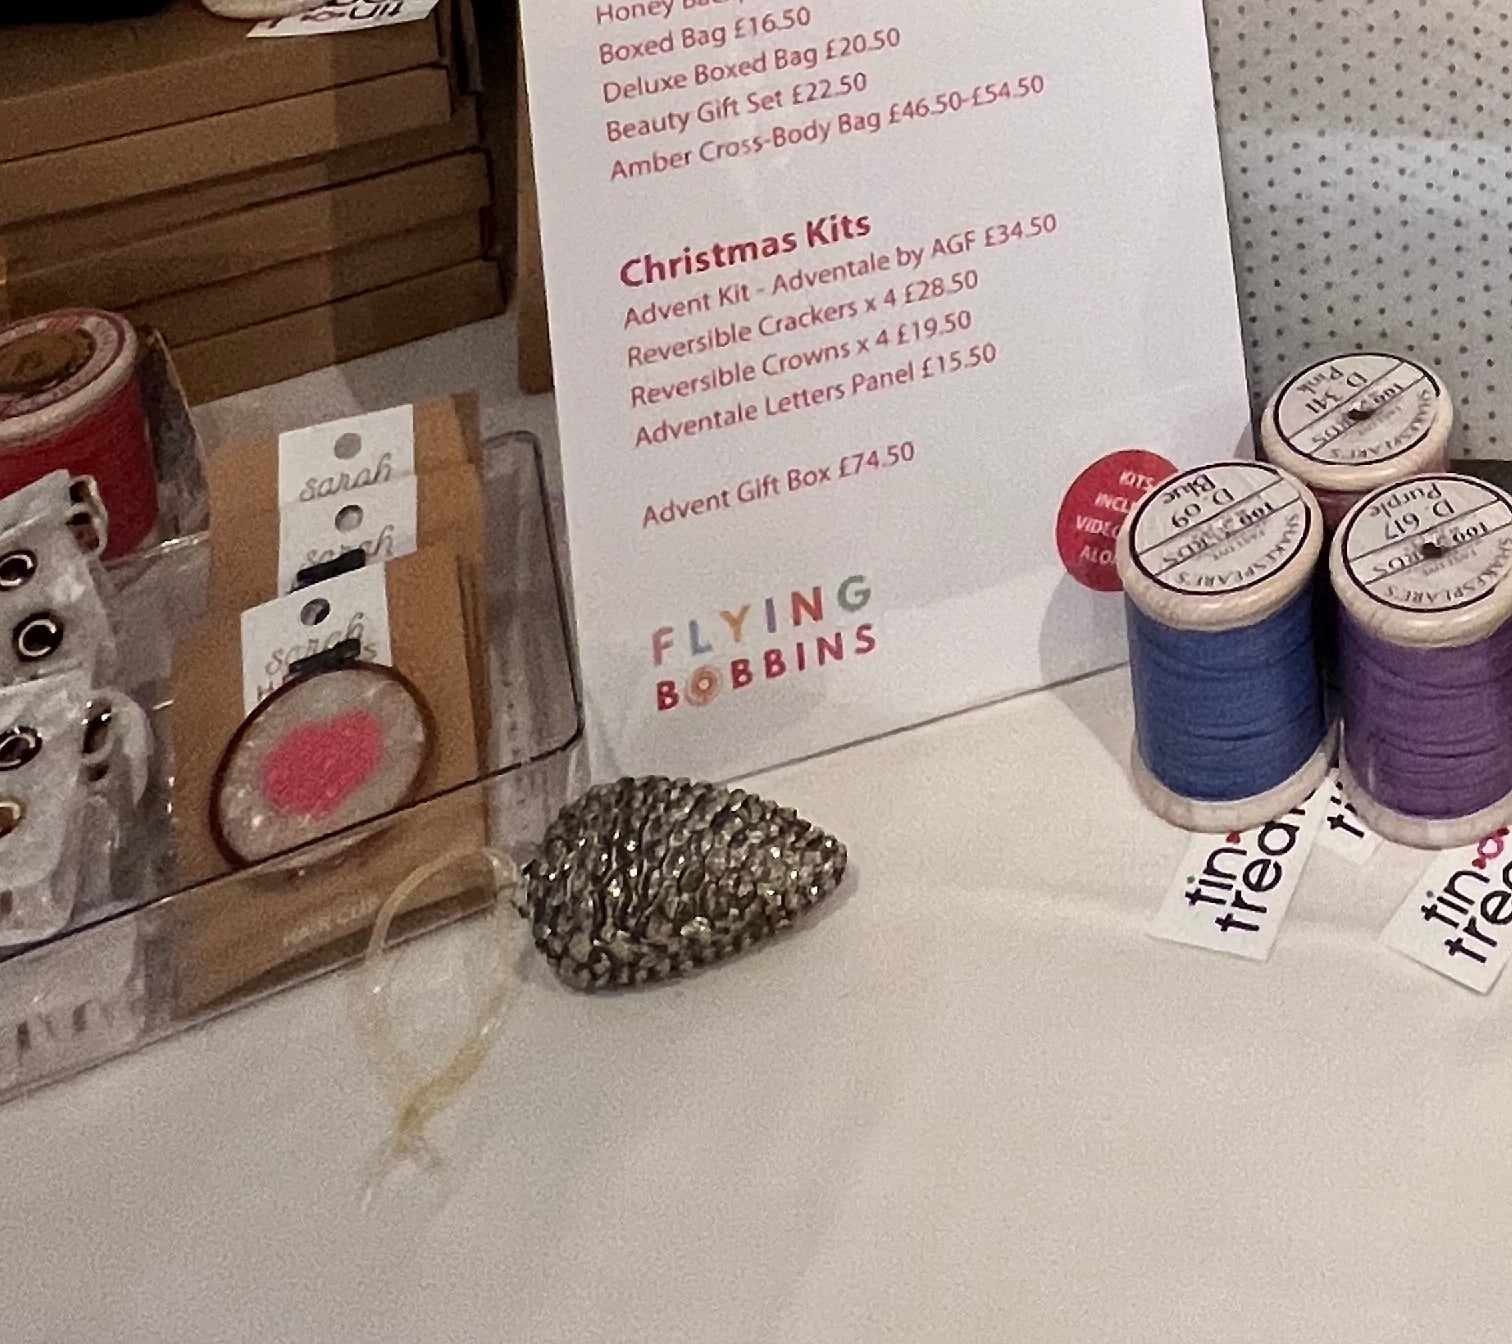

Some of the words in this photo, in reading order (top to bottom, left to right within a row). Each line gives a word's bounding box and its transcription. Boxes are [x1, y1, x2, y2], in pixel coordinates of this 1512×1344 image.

[599, 29, 674, 65] Boxed
[682, 25, 726, 48] Bag
[734, 6, 811, 39] £16.50
[602, 71, 688, 104] Deluxe
[694, 50, 768, 86] Boxed
[774, 47, 818, 70] Bag
[825, 26, 901, 60] £20.50
[606, 111, 690, 142] Beauty
[697, 95, 739, 124] Gift
[746, 89, 783, 114] Set
[792, 72, 867, 105] £22.50
[610, 149, 693, 181] Amber
[699, 119, 831, 162] Cross-Body
[838, 111, 882, 134] Bag
[889, 74, 1045, 125] £46.50-£54.50
[619, 231, 797, 288] Christmas
[806, 213, 872, 248] Kits
[624, 291, 711, 330] Advent
[718, 283, 750, 307] Kit
[771, 251, 890, 296] Adventale
[896, 246, 925, 270] by
[931, 229, 977, 258] AGF
[984, 212, 1057, 248] £34.50
[627, 322, 752, 368] Reversible
[758, 298, 858, 337] Crackers
[864, 297, 878, 312] x
[883, 288, 897, 306] 4
[903, 269, 979, 305] £28.50
[630, 362, 756, 409] Reversible
[762, 339, 851, 378] Crowns
[857, 337, 870, 353] x
[875, 329, 889, 346] 4
[897, 309, 972, 345] £19.50
[1296, 365, 1345, 393] Pink
[635, 403, 758, 449] Adventale
[764, 383, 846, 417] Letters
[851, 361, 915, 396] Panel
[921, 342, 997, 379] £15.50
[1305, 390, 1344, 415] 341
[298, 451, 393, 503] sarah
[642, 490, 731, 529] Advent
[736, 475, 780, 504] Gift
[787, 464, 831, 492] Box
[838, 440, 915, 479] £74.50
[1094, 492, 1136, 514] INCL
[1119, 470, 1155, 491] KITS
[1161, 473, 1217, 505] Blue
[1369, 481, 1443, 518] Purple
[1080, 545, 1116, 566] ALO
[1384, 512, 1421, 540] 617
[652, 574, 872, 667] FLYING
[656, 622, 876, 712] BOBBINS
[1184, 846, 1248, 907] tin
[1214, 788, 1317, 932] trea
[1420, 868, 1491, 928] tin
